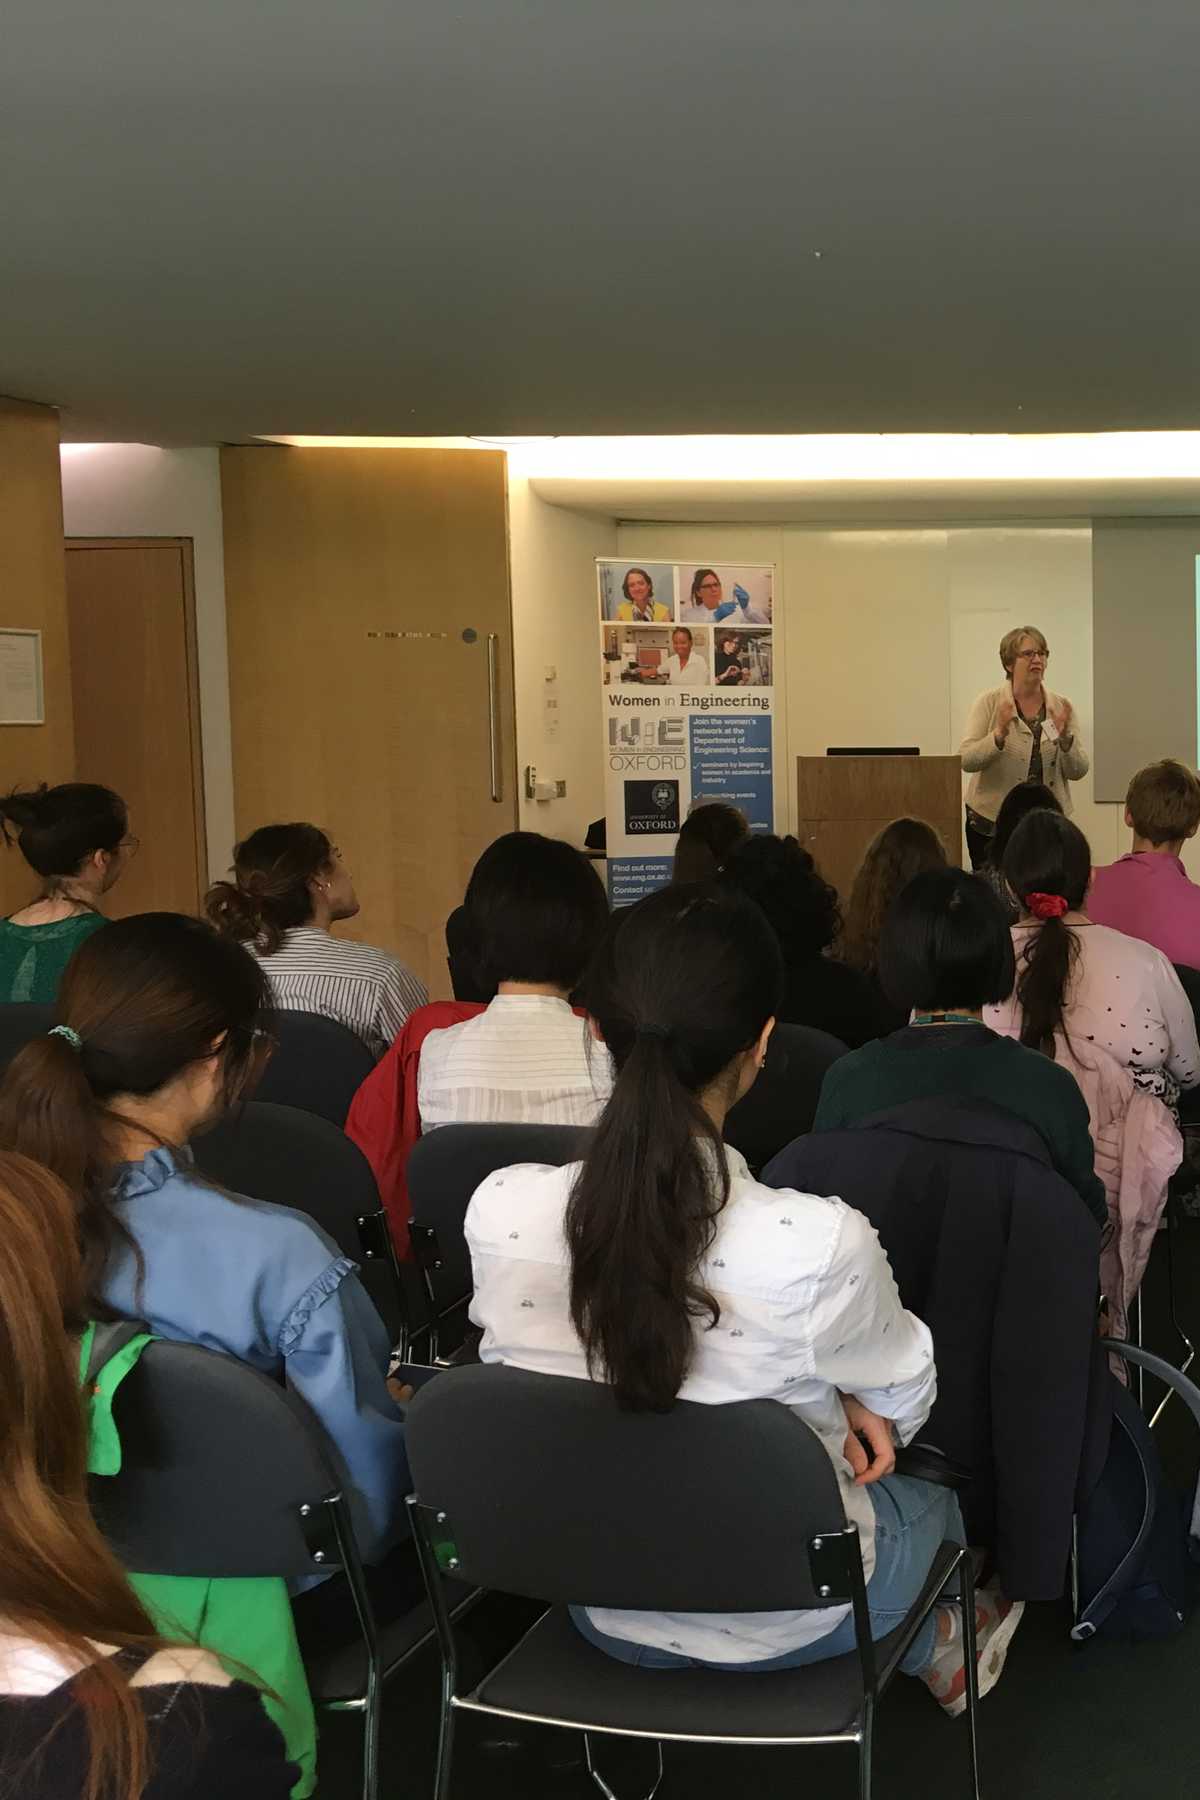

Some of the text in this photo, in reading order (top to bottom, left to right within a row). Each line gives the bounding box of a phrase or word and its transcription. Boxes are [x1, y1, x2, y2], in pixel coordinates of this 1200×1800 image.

[608, 693, 770, 710] Women in Engineering
[725, 718, 757, 726] women's
[693, 737, 736, 745] Department
[693, 746, 738, 755] Engineering
[609, 755, 687, 771] OXFORD
[629, 820, 677, 830] OXFORD
[612, 864, 630, 872] Find
[612, 886, 643, 894] Contact
